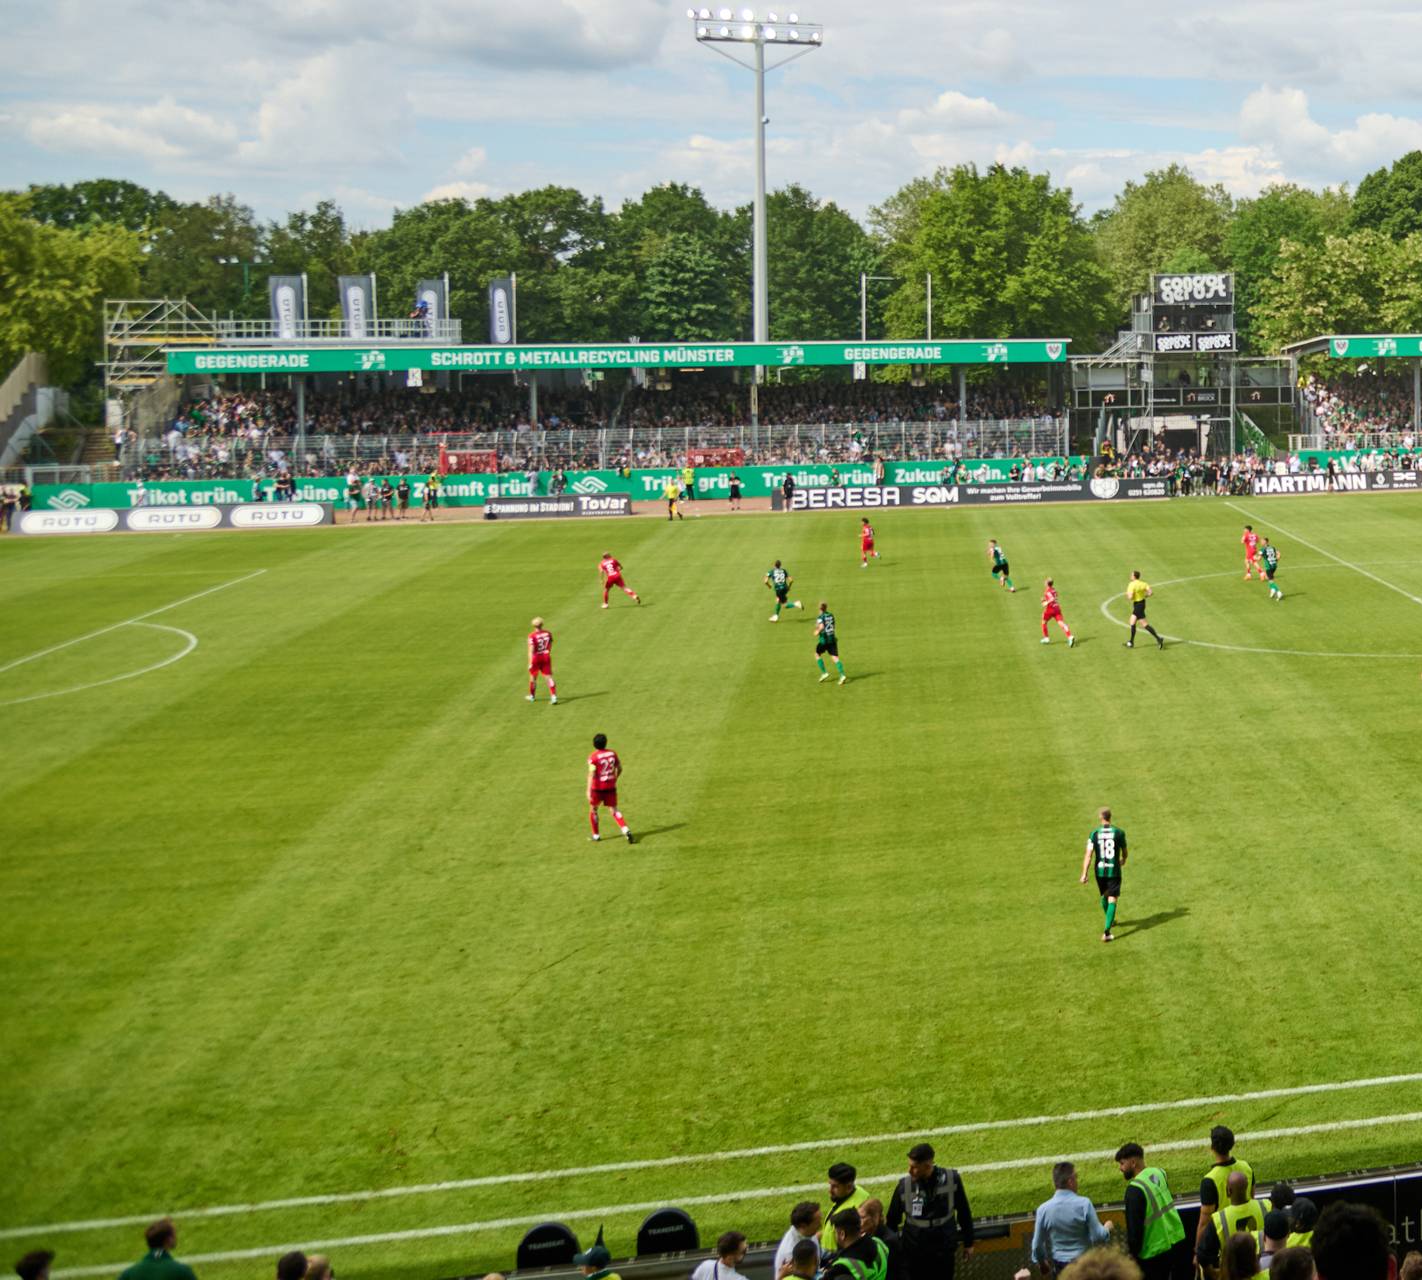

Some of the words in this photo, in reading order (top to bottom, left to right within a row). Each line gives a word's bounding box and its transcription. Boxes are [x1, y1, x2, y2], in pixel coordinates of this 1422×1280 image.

[195, 354, 310, 369] GEGENGERADE
[431, 352, 502, 366] SCHROTT
[505, 352, 516, 365] &
[519, 349, 660, 365] METALLRECYCLING
[663, 347, 734, 363] MÜNSTER
[844, 347, 942, 361] GEGENGERADE
[762, 472, 835, 487] Triüne
[1254, 473, 1366, 494] HARTMANN
[127, 489, 187, 506] Tikot
[792, 487, 900, 509] BERESA
[912, 486, 959, 504] SQM
[600, 757, 615, 776] 23
[1097, 838, 1116, 860] 18
